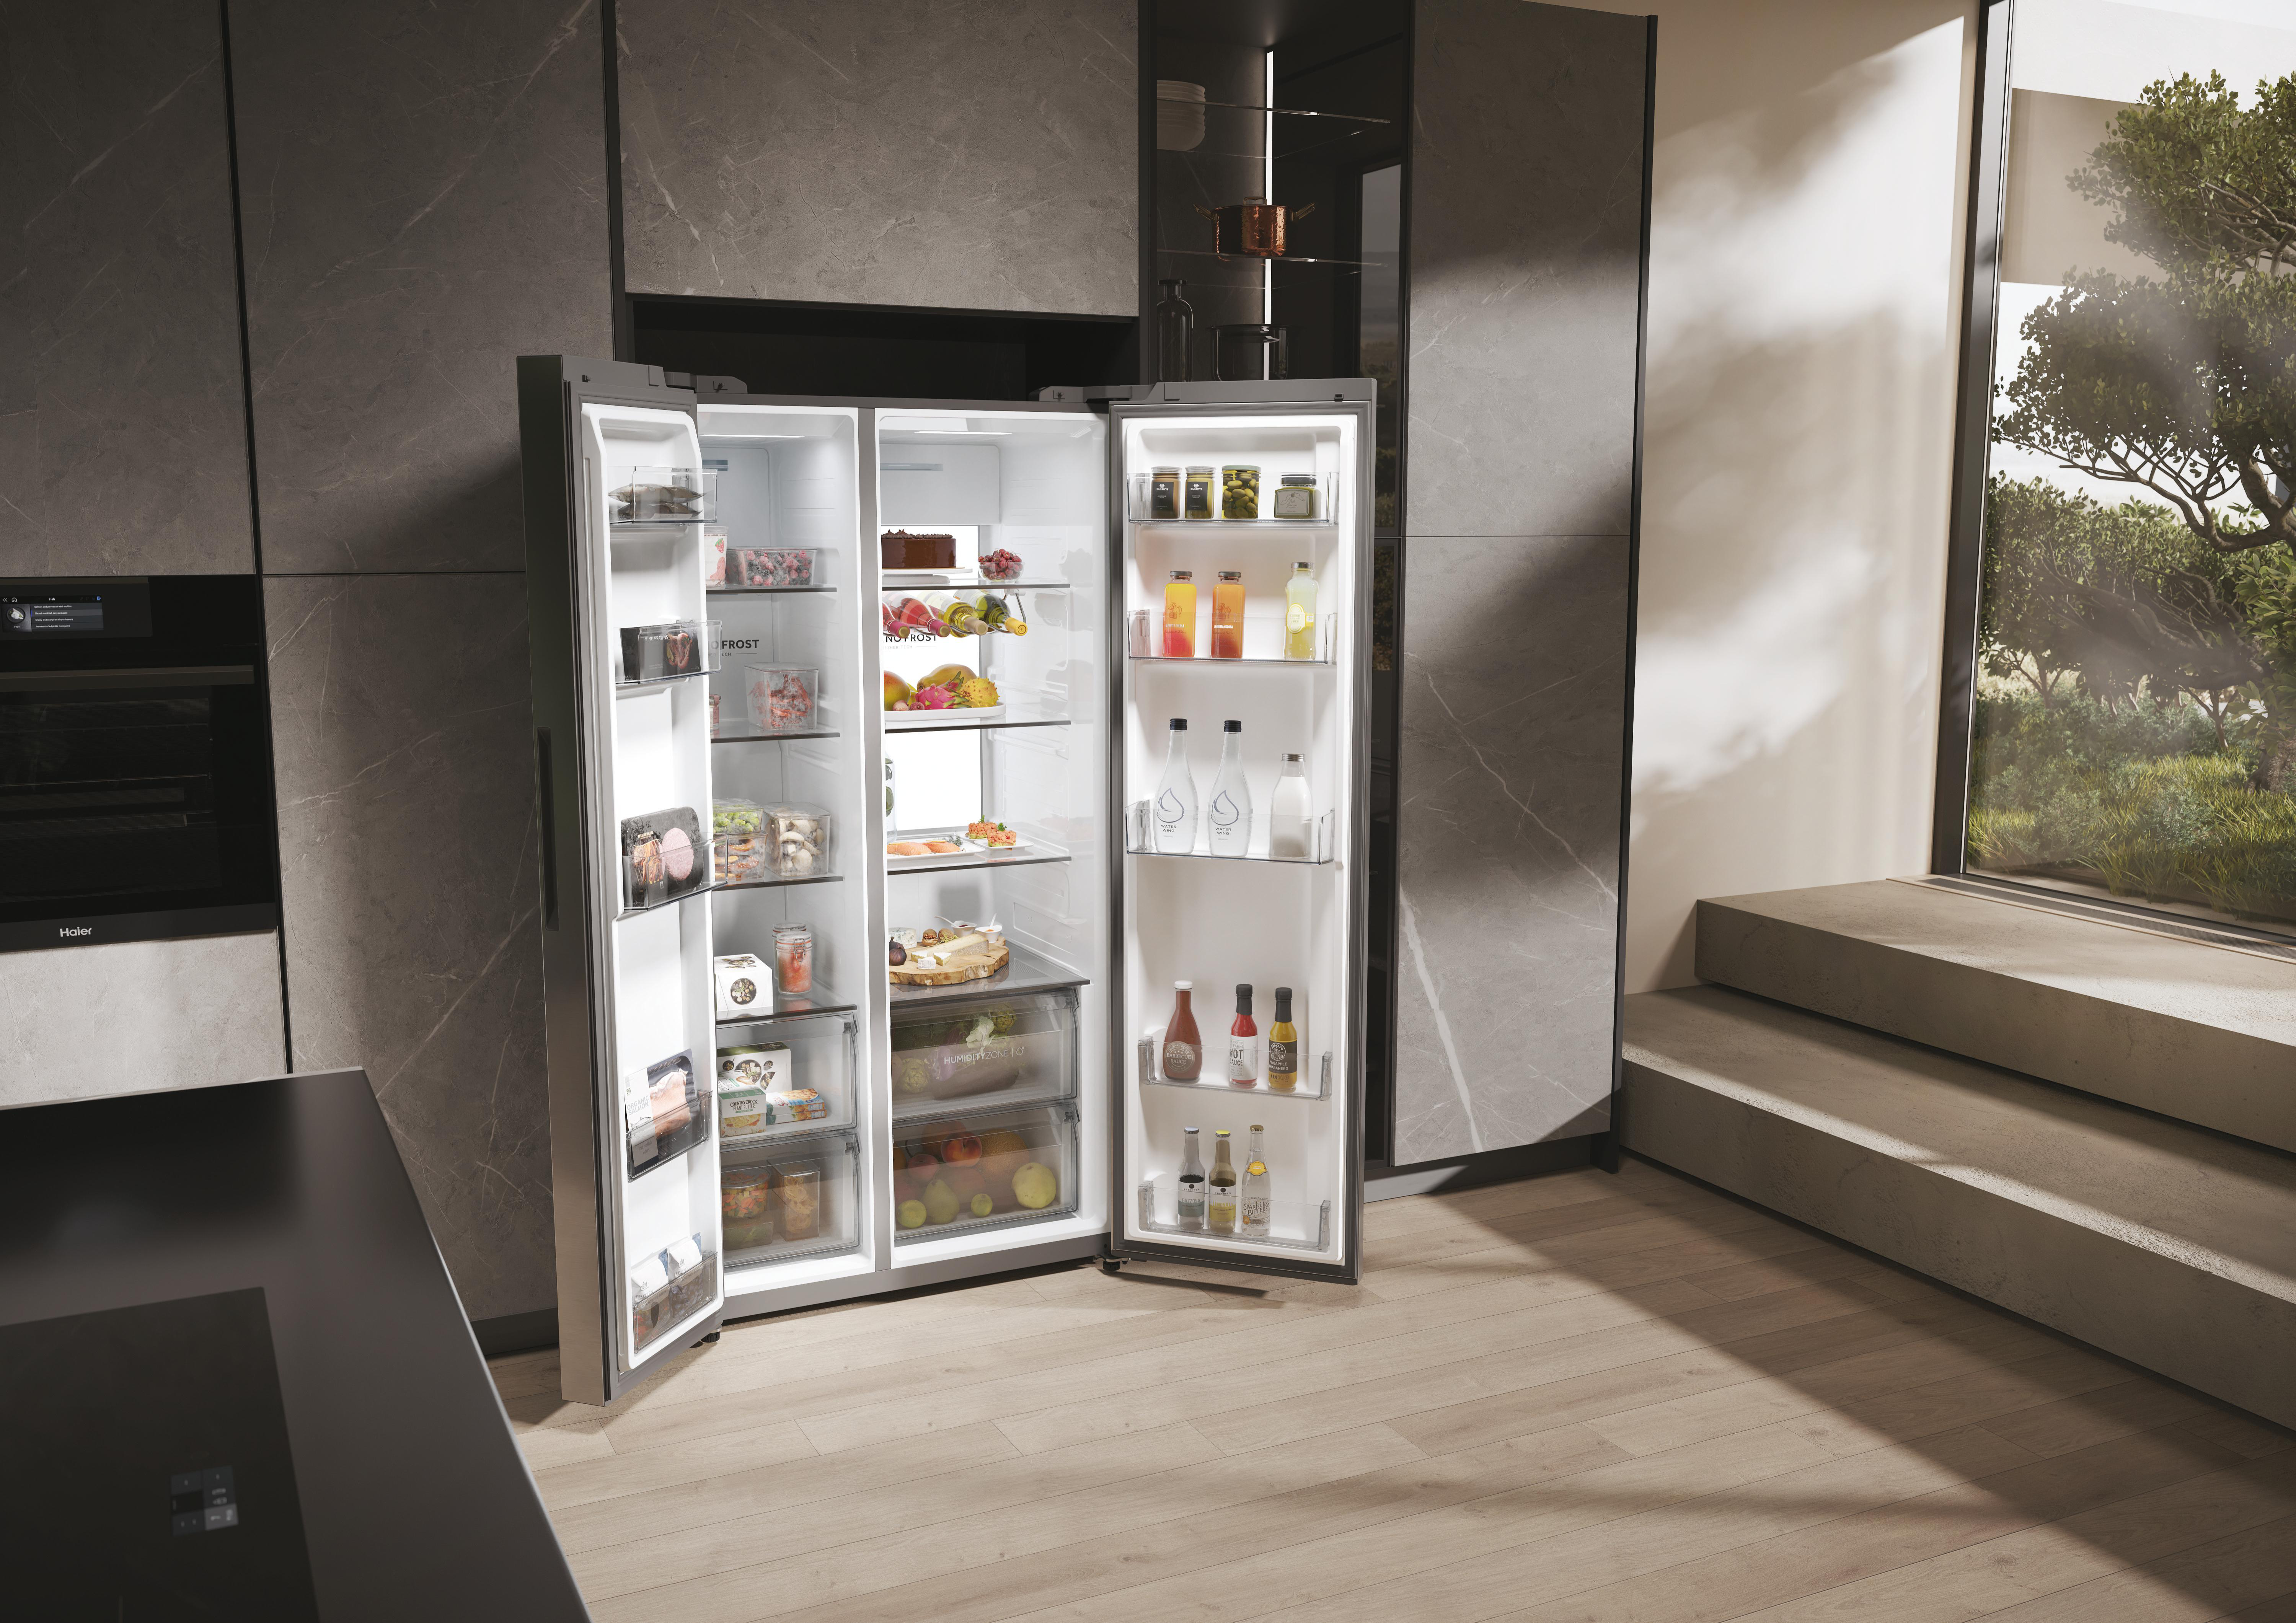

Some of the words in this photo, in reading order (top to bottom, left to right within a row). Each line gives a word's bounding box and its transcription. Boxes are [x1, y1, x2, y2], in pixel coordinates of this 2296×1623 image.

[722, 639, 759, 649] FROST
[638, 831, 653, 839] HAMBURGER
[60, 927, 92, 937] Haier
[627, 1095, 649, 1110] ORGANIC
[628, 1101, 649, 1116] SALMON
[1246, 1207, 1268, 1216] BITTERS
[636, 1289, 654, 1299] FROZEN
